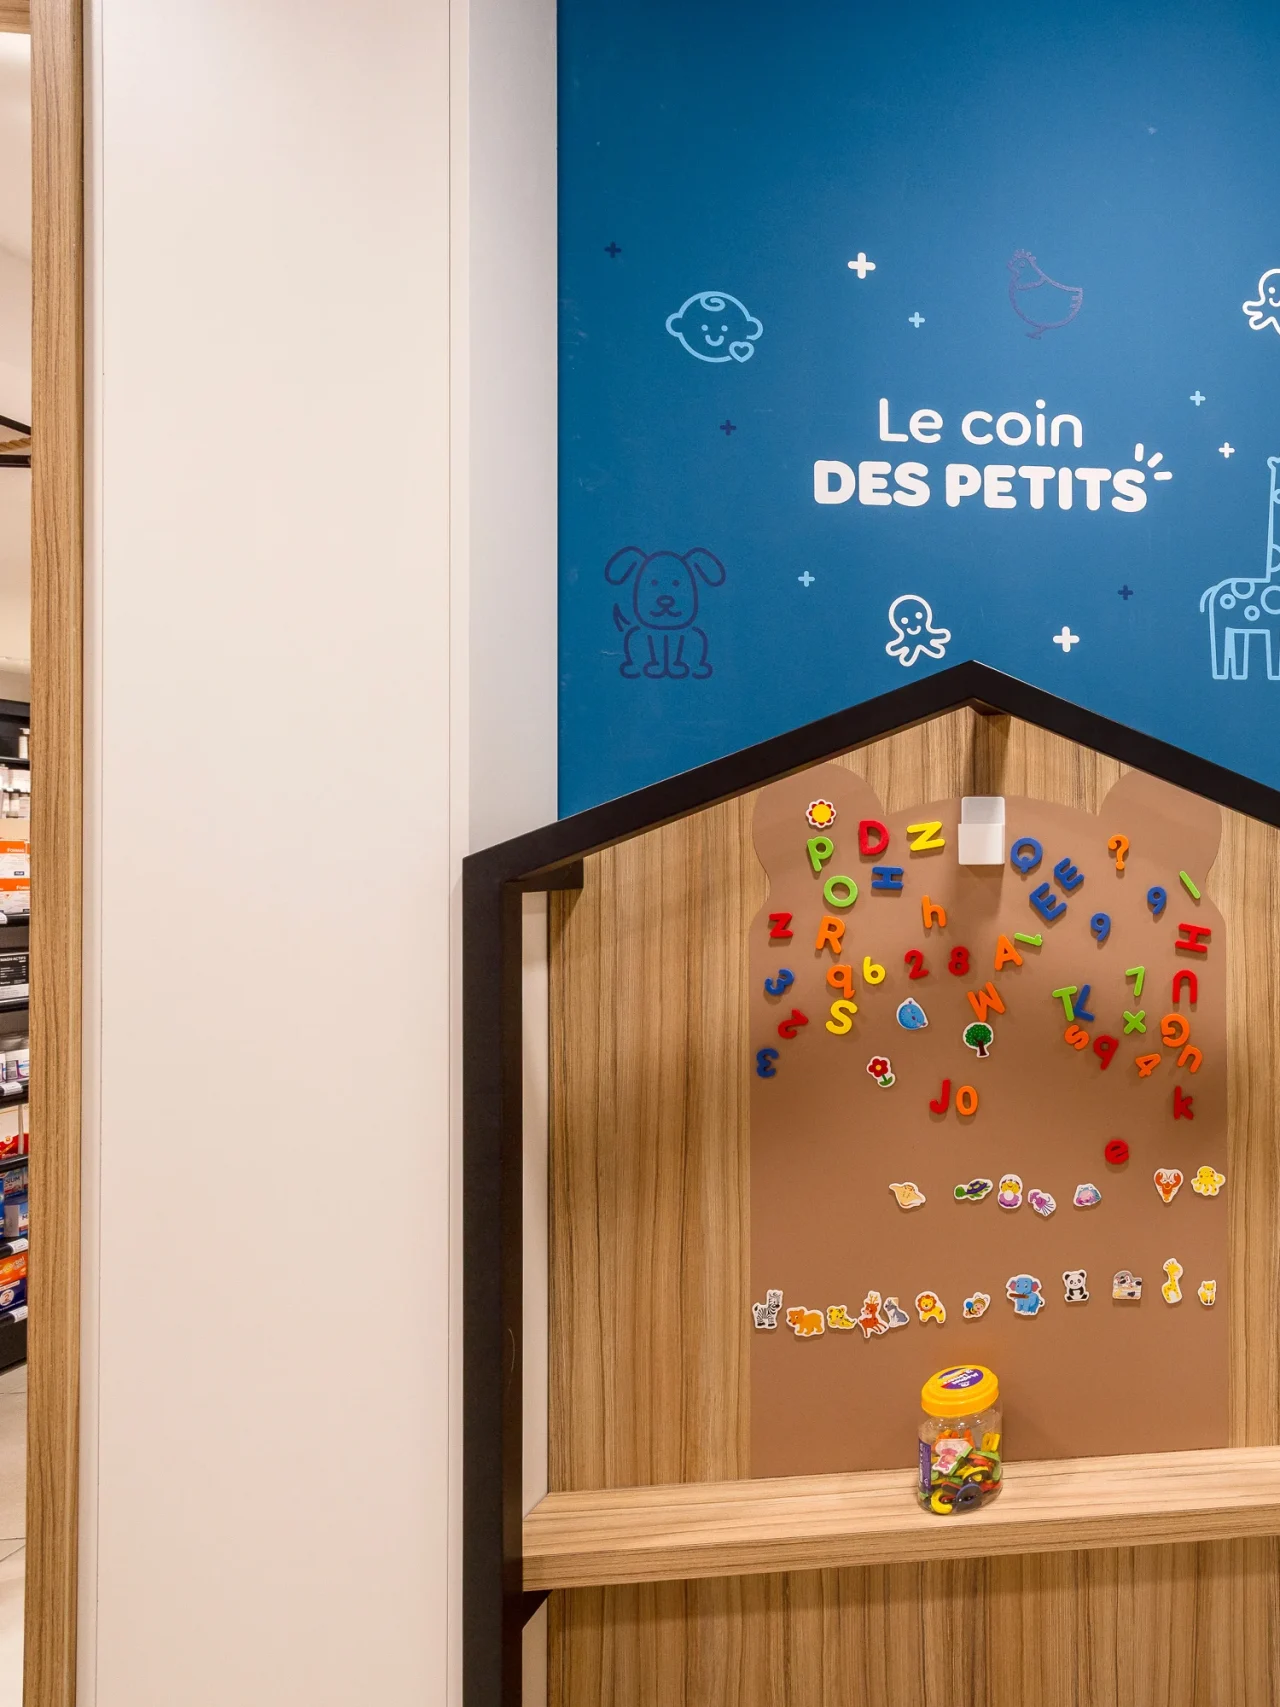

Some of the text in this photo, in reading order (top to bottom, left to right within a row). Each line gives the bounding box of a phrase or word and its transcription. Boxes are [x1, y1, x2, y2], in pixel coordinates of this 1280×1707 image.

[879, 397, 1083, 448] Le coin
[813, 459, 1147, 513] DES PETITS
[859, 820, 890, 856] D
[1010, 837, 1043, 873] Q
[815, 915, 846, 955] R
[994, 933, 1024, 971] A
[904, 949, 930, 980] 2
[948, 945, 970, 977] 8
[825, 999, 859, 1036] S
